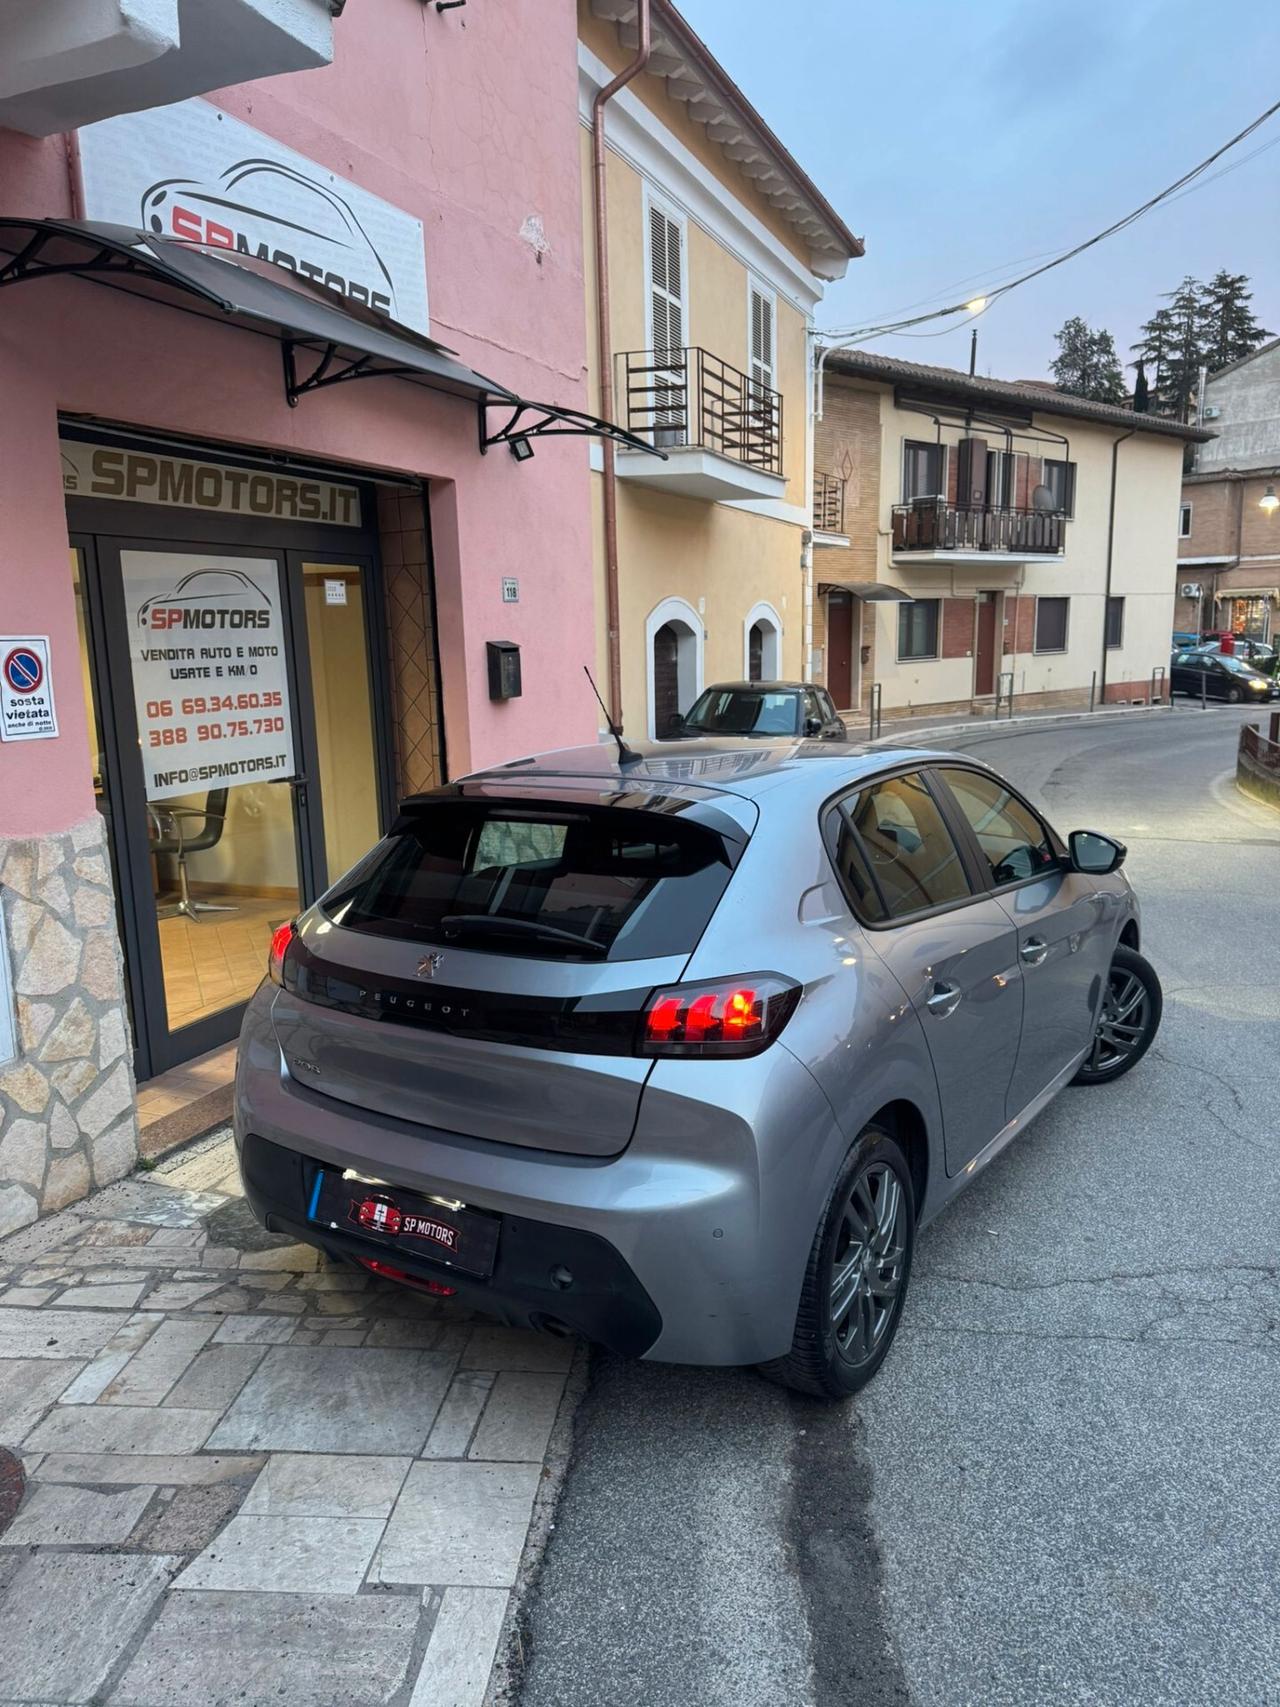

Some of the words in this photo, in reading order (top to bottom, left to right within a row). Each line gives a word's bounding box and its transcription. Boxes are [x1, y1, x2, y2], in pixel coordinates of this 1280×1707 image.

[91, 450, 357, 523] SPMOTORS.IT
[151, 608, 270, 630] SPMOTORS
[141, 648, 195, 662] VENDITA
[200, 647, 232, 659] AUTO
[237, 647, 244, 657] E
[249, 646, 278, 657] MOTO
[170, 667, 211, 680] USATE
[216, 666, 223, 677] E
[228, 665, 245, 676] KM
[6, 708, 49, 720] vietata
[10, 696, 44, 707] sosta
[146, 700, 173, 718] 06
[181, 691, 283, 715] 69.34.60.35
[149, 727, 188, 747] 388
[197, 716, 285, 741] 90.75.730
[154, 754, 287, 788] INFO@SPMOTORS.IT
[359, 989, 470, 1017] PEUGEOT
[403, 1217, 417, 1235] SP
[417, 1220, 454, 1246] MOTORS
